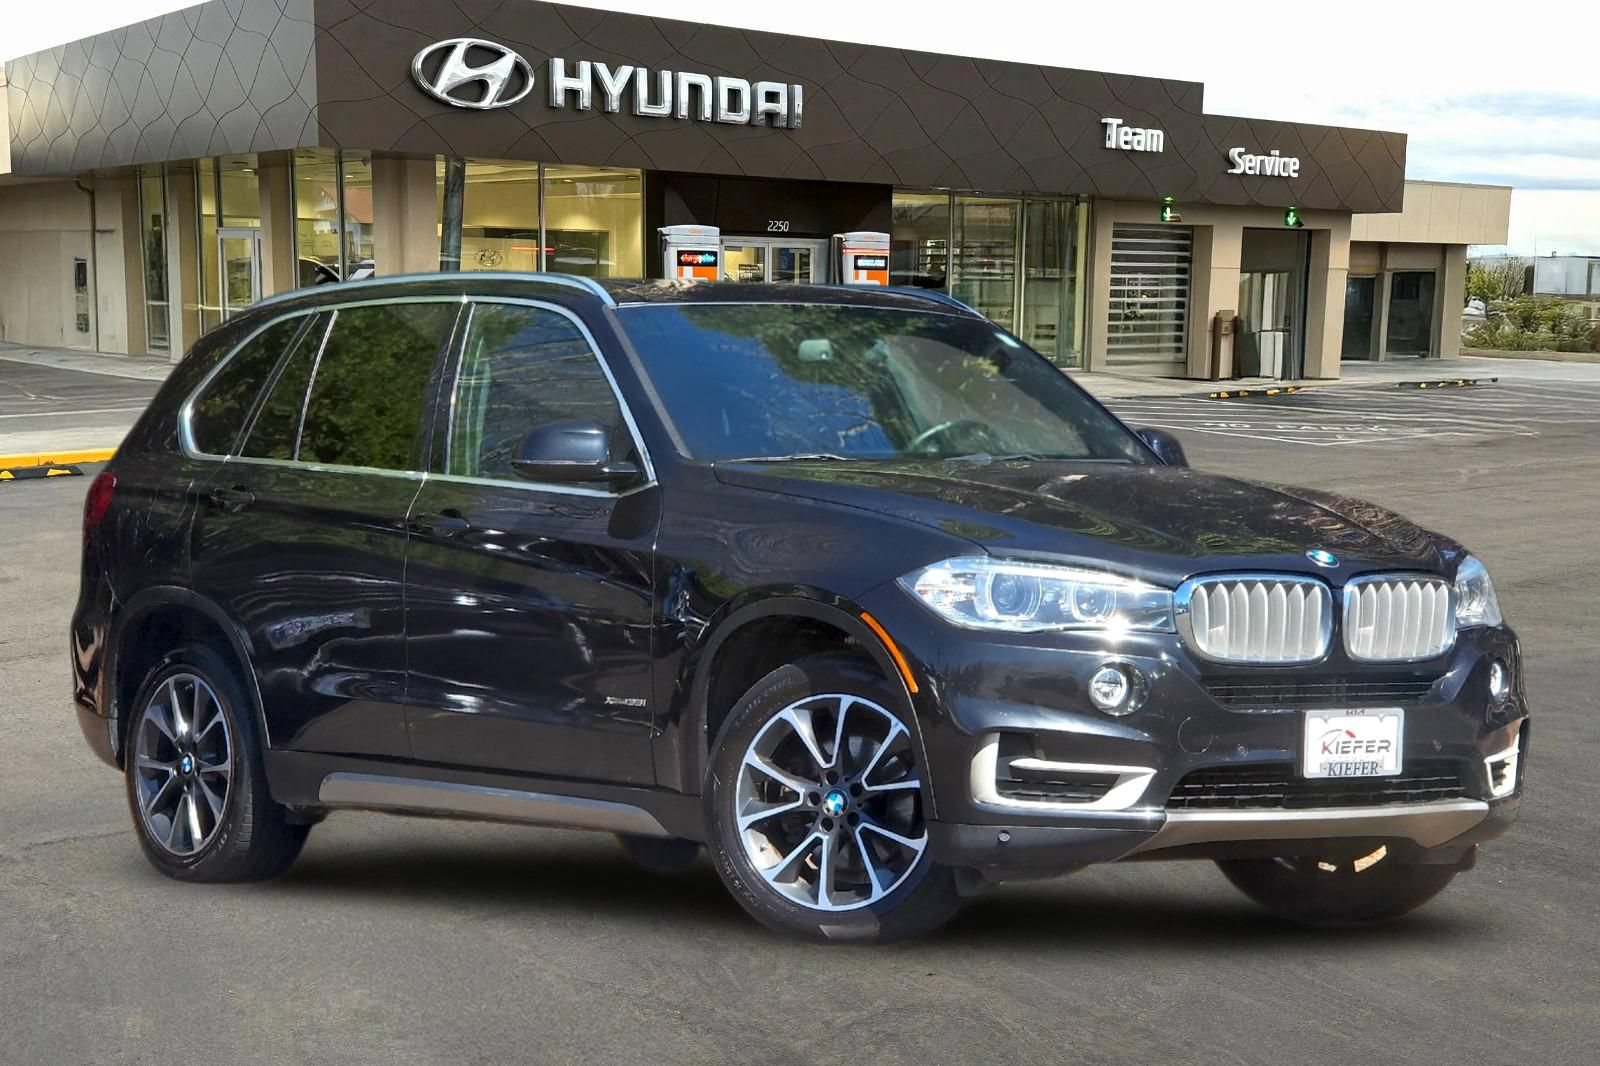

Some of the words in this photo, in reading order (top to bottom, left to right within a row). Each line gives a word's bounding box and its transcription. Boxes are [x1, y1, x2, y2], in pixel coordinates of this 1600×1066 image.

[549, 56, 803, 129] HYUNDAI
[1101, 117, 1164, 153] Team
[1227, 147, 1300, 178] Service
[767, 220, 789, 232] 2250
[1321, 739, 1391, 755] KIEFER
[1327, 761, 1379, 777] KIEFER
